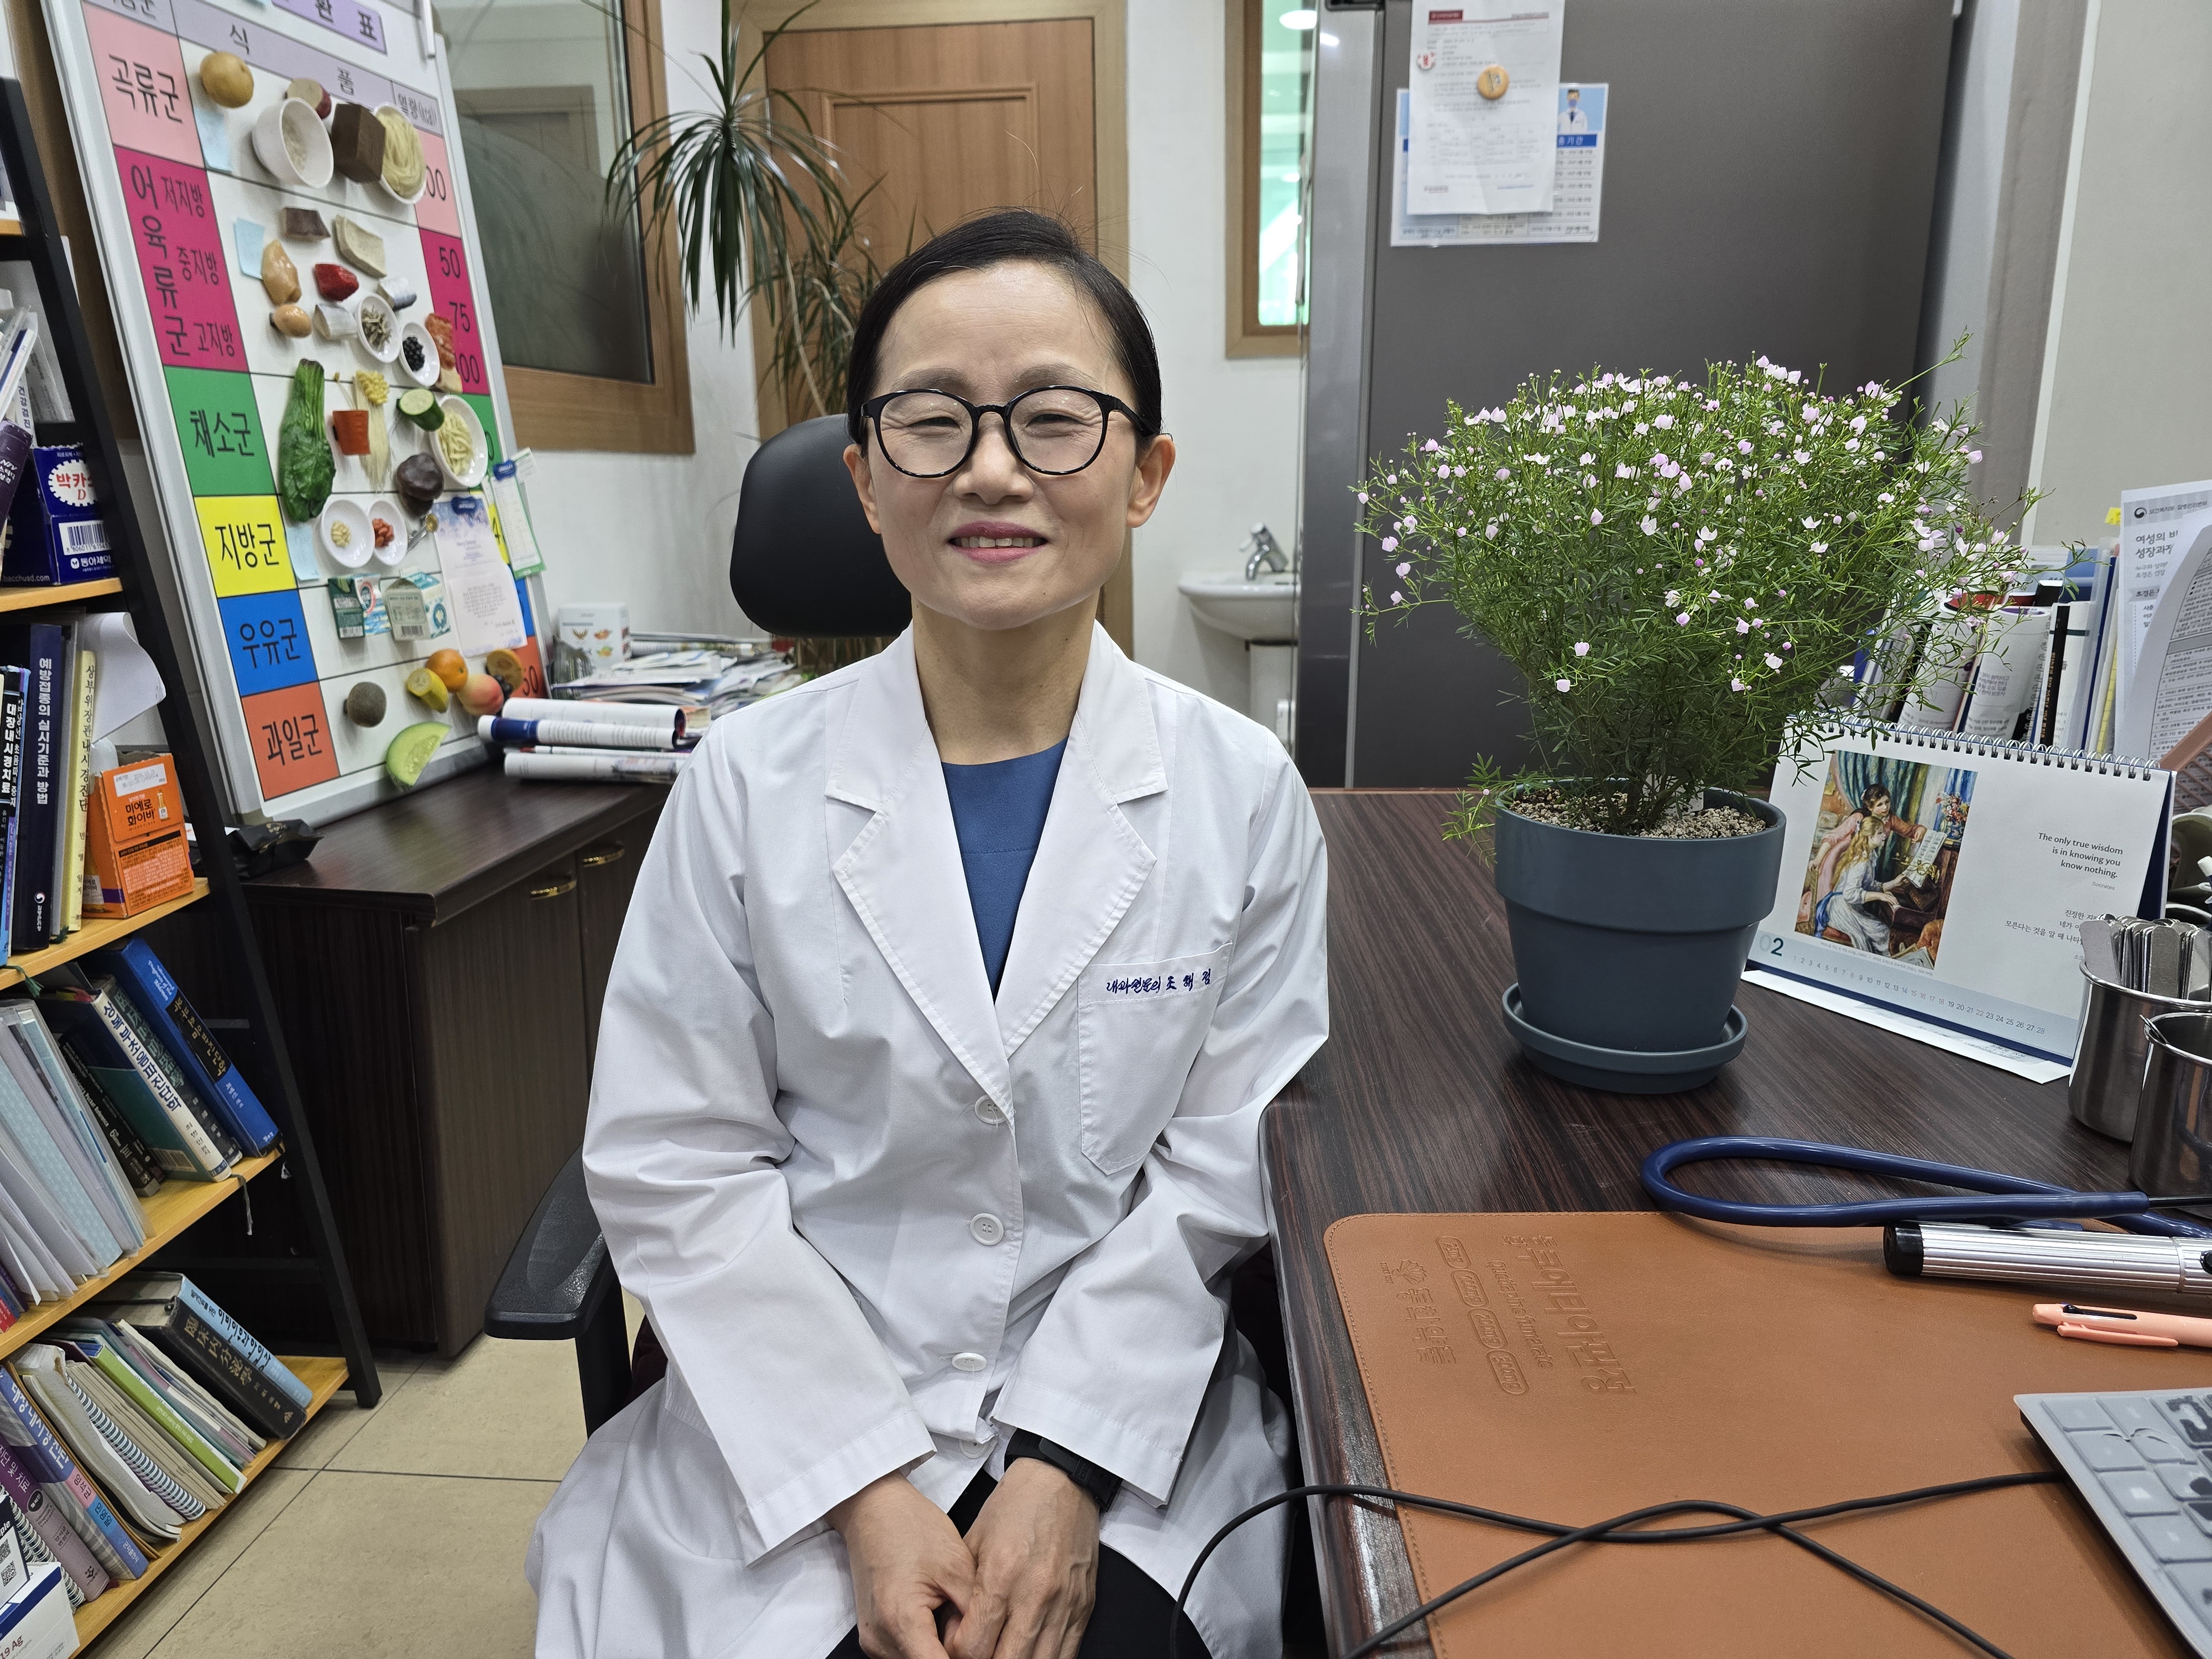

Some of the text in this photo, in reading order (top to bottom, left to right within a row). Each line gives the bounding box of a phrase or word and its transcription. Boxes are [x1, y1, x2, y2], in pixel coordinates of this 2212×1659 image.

[358, 10, 377, 40] 표
[229, 24, 354, 96] 식 품
[108, 53, 183, 124] 곡류군
[160, 176, 205, 218] 저지방
[426, 167, 447, 201] 00
[176, 246, 219, 286] 중지방
[439, 246, 461, 278] 50
[448, 301, 471, 333] 75
[194, 322, 236, 357] 고지방
[189, 409, 255, 458] 채소군
[77, 489, 86, 500] D
[214, 523, 280, 570] 지방군
[2135, 531, 2166, 545] 여성의
[239, 618, 301, 670] 우유군
[36, 658, 52, 805] 예방접종의 실시기준과 방법
[79, 665, 96, 812] 상부위장관내시경진단
[262, 714, 322, 767] 과일군
[1, 703, 17, 794] 대장내시경치료
[125, 799, 153, 814] 미에로
[127, 809, 155, 826] 화이바
[2038, 832, 2123, 855] The only true wisdom
[2060, 848, 2068, 856] in
[2069, 849, 2104, 864] knowing
[2105, 858, 2121, 867] you
[2060, 859, 2118, 879] know nothing.
[2091, 881, 2115, 890] Socrates
[2005, 920, 2032, 932] 모른다는
[2033, 927, 2047, 936] 것을
[2059, 921, 2073, 930] 네가
[2064, 909, 2085, 920] 진정한
[1106, 976, 1161, 994] 내과전문의
[174, 997, 227, 1077] 복부초음파진단학
[103, 1000, 182, 1112] 상복부초음파진단학
[1458, 1274, 1483, 1303] 100mg
[1475, 1313, 1501, 1345] 200mg
[1493, 1355, 1524, 1392] 300mg
[1517, 1246, 1637, 1395] 쿠에티아핀정
[12, 1472, 33, 1494] 치료
[71, 1474, 93, 1499] 양석균
[92, 1502, 114, 1527] 민영일
[8, 1634, 27, 1652] Ag
